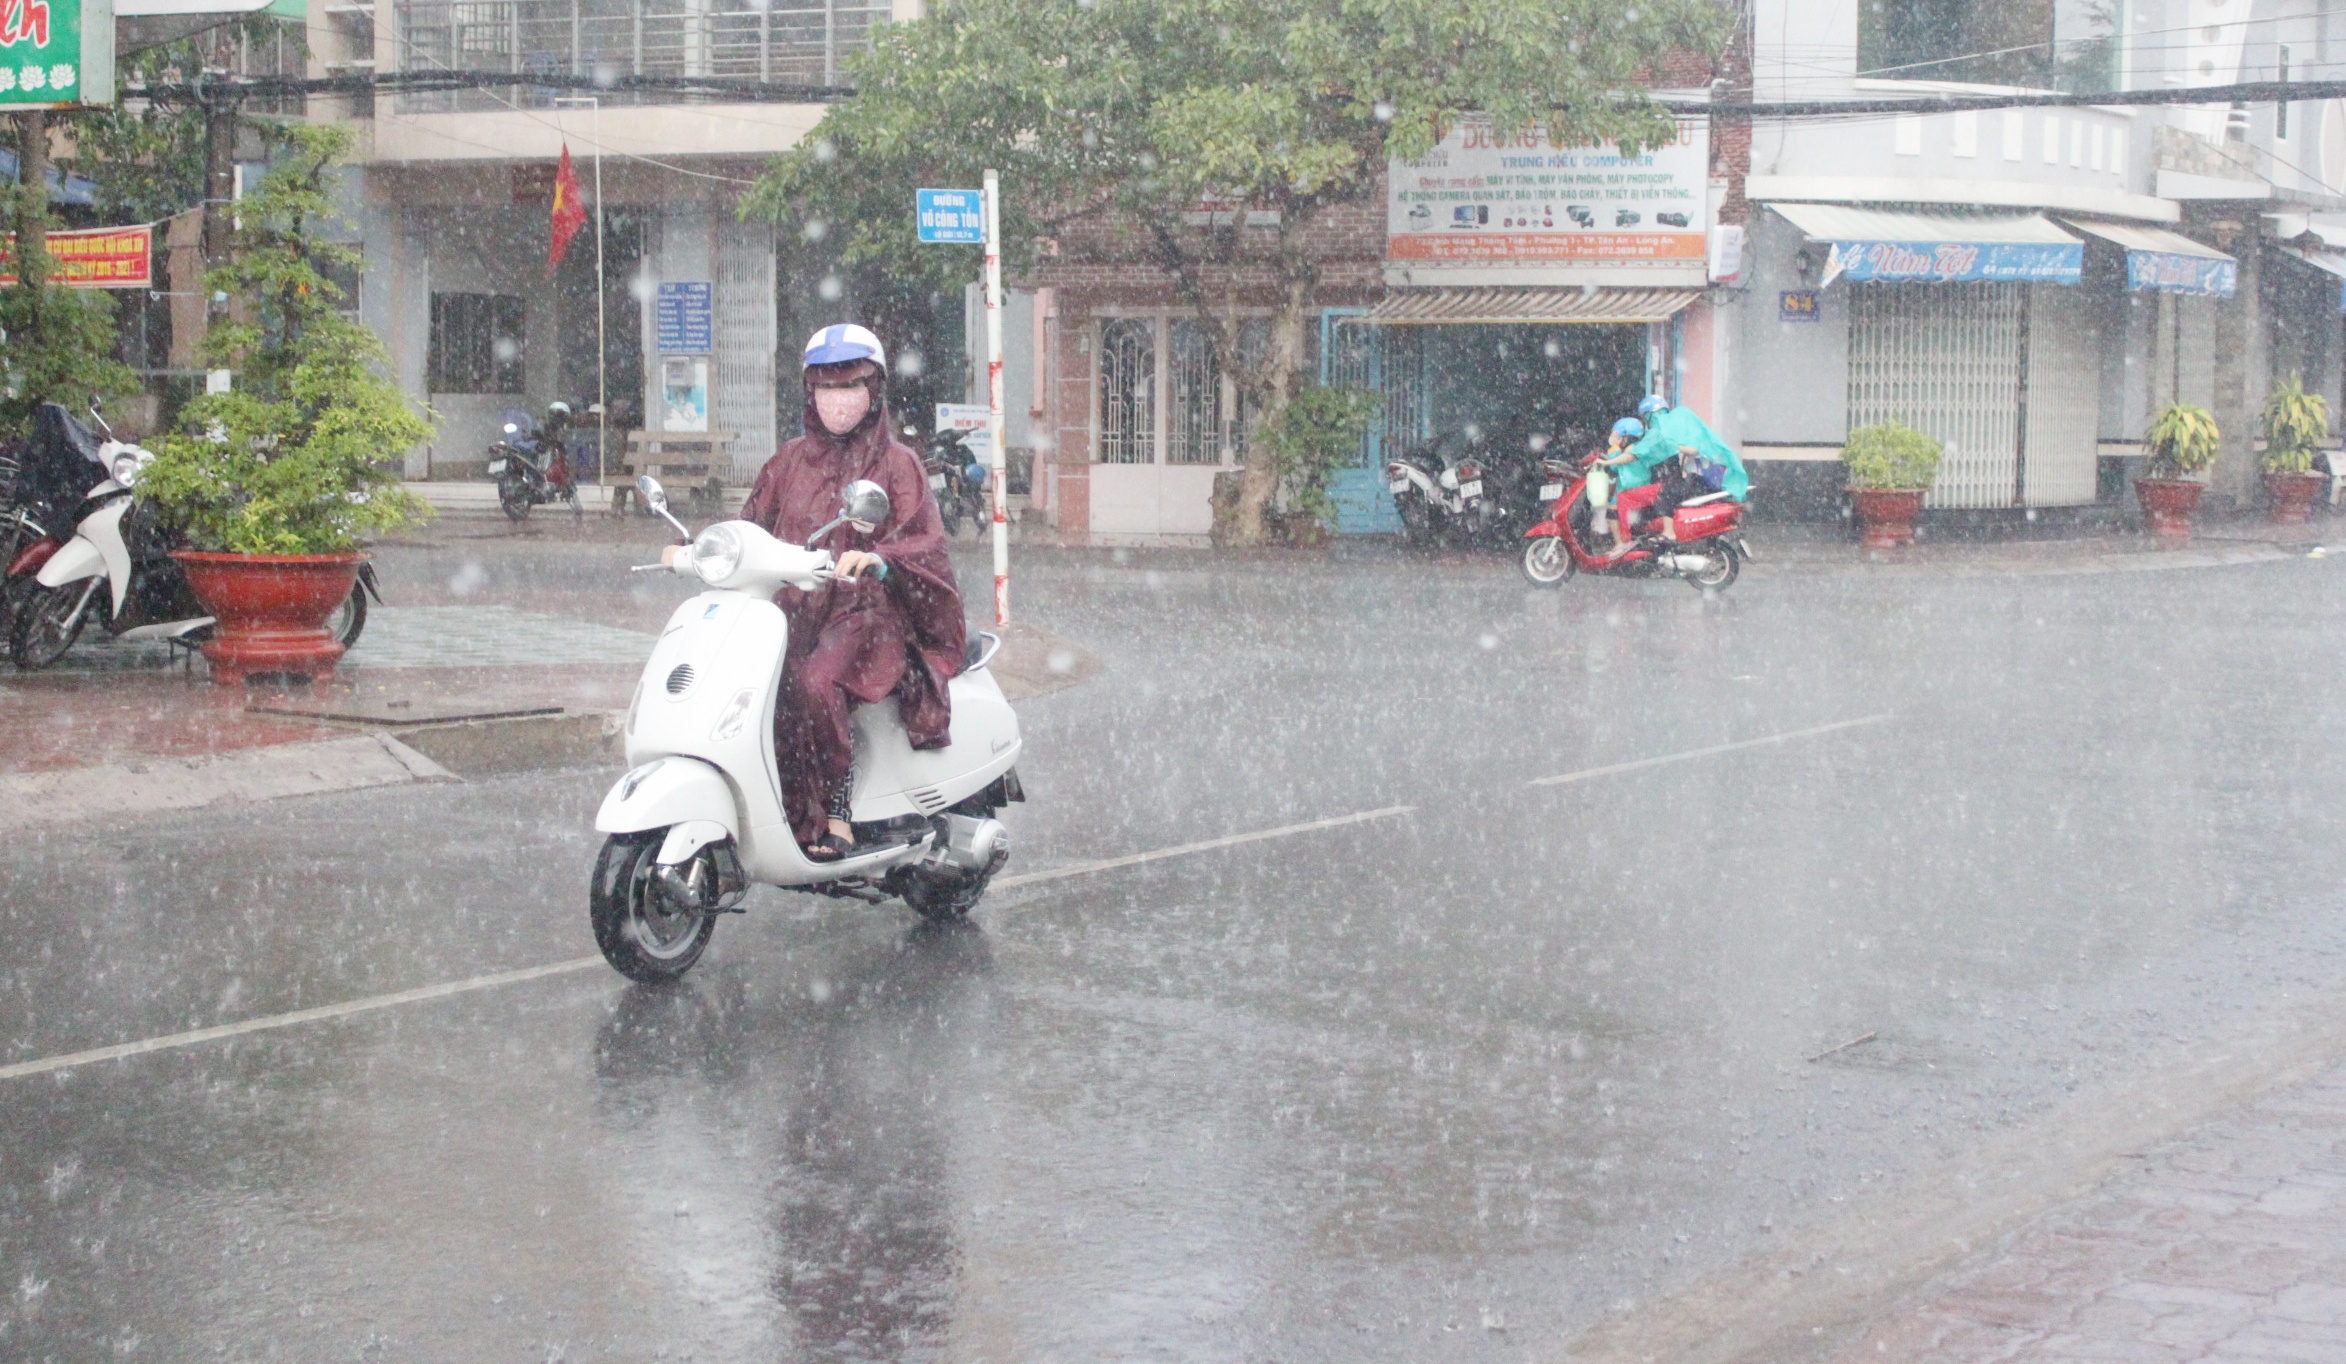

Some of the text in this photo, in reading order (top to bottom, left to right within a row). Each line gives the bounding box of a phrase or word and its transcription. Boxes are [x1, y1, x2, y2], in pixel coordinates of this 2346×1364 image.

[1501, 155, 1544, 168] TRUNG
[1582, 154, 1653, 168] COMPUTER
[1486, 173, 1503, 186] MÁY
[1538, 172, 1555, 186] MÁY
[1607, 172, 1625, 184] MÁY
[1627, 173, 1674, 184] PHOTOCOPY
[933, 193, 965, 206] ĐƯỜNG
[1438, 190, 1471, 201] CAMERA
[1472, 190, 1494, 201] QUAN
[922, 209, 934, 227] VÕ
[935, 209, 959, 228] CÔNG
[1616, 235, 1628, 244] An
[1636, 236, 1659, 246] Long
[1784, 293, 1812, 313] 84
